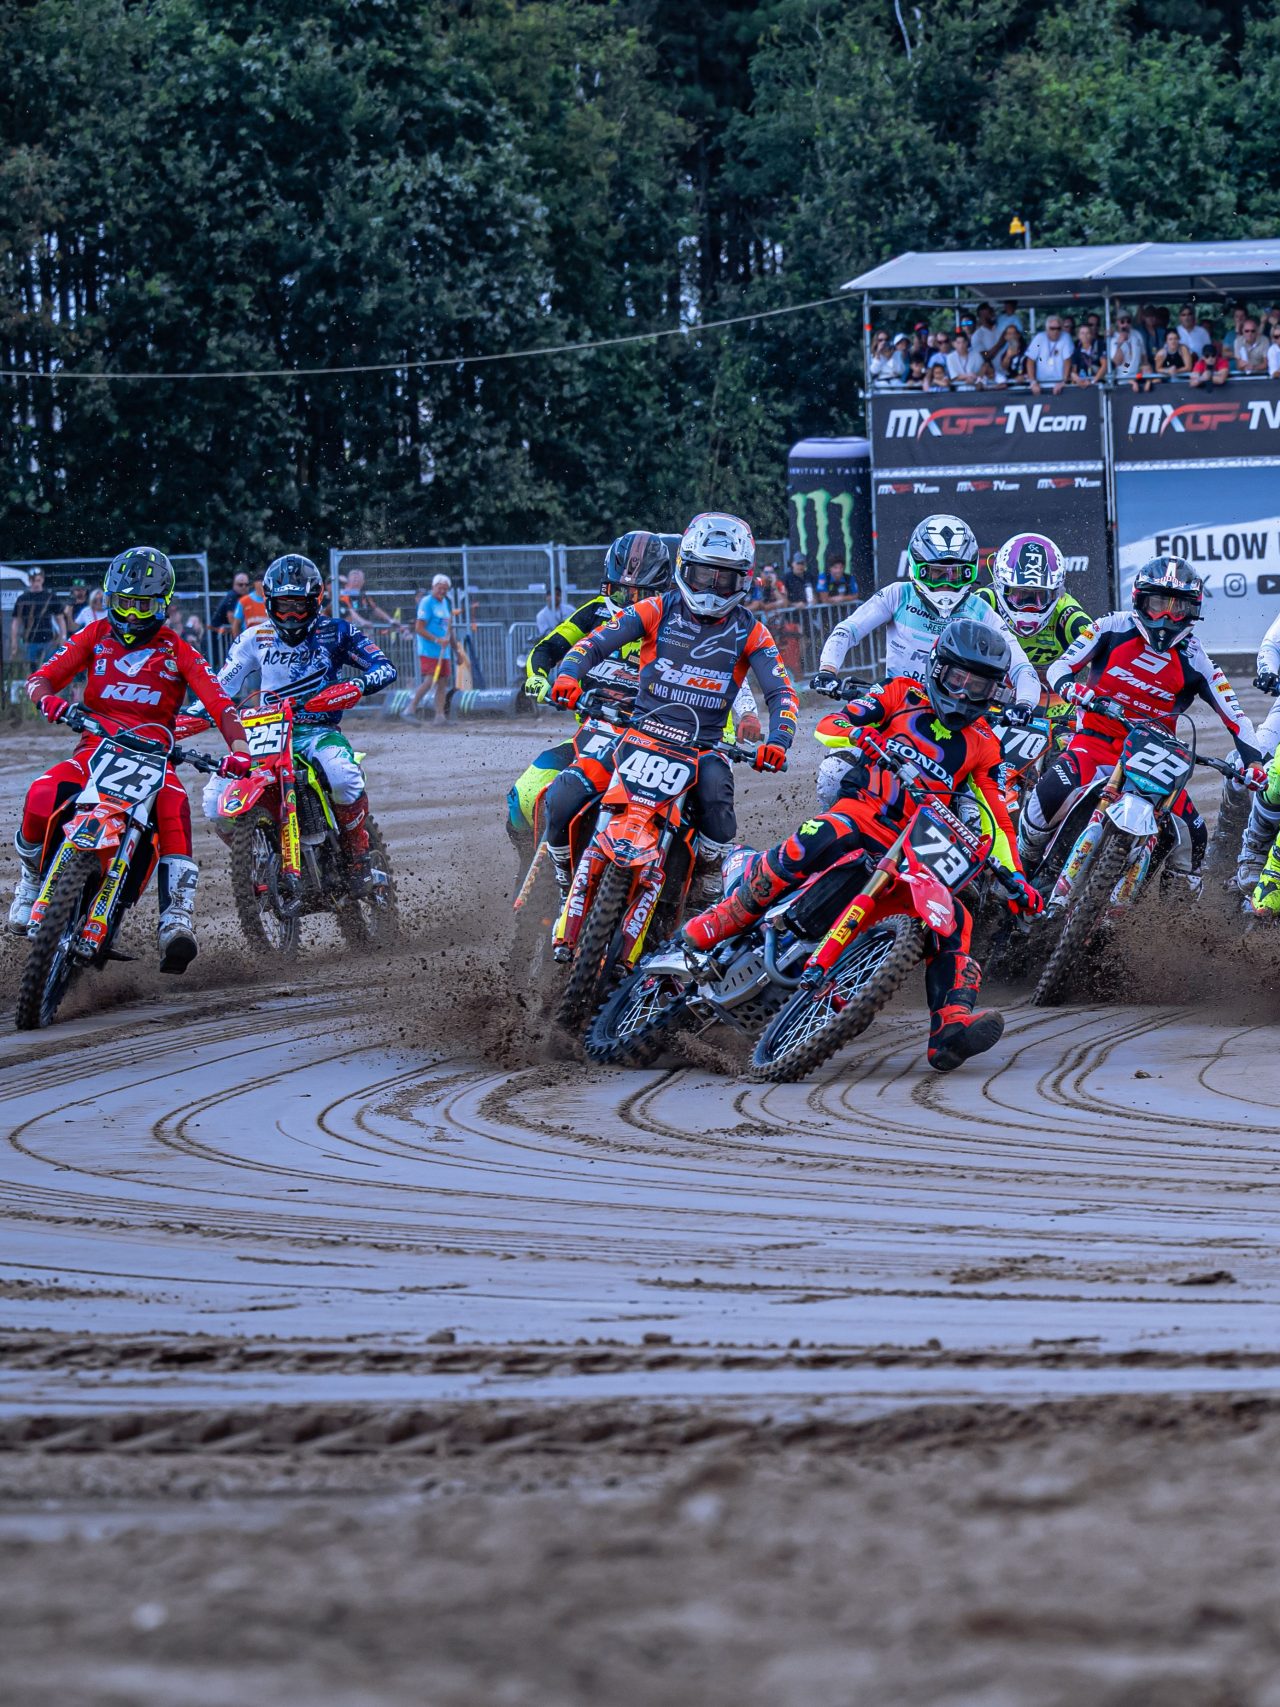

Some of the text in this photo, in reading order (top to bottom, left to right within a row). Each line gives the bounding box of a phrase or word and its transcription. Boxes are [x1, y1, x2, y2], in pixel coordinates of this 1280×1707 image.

[1155, 531, 1268, 562] FOLLOW
[681, 664, 733, 680] RACING
[686, 677, 722, 691] KTM
[100, 682, 162, 706] KTM
[670, 688, 722, 709] NUTRITION
[245, 722, 290, 756] 25
[642, 724, 688, 743] RENTHAL
[90, 752, 163, 801] 123
[618, 749, 691, 796] 489
[885, 738, 954, 791] HONDA
[1051, 764, 1072, 786] SHOT
[1125, 742, 1190, 785] 22
[630, 795, 656, 808] MOTUL
[930, 800, 981, 850] RENTHAL
[912, 825, 970, 887] 73
